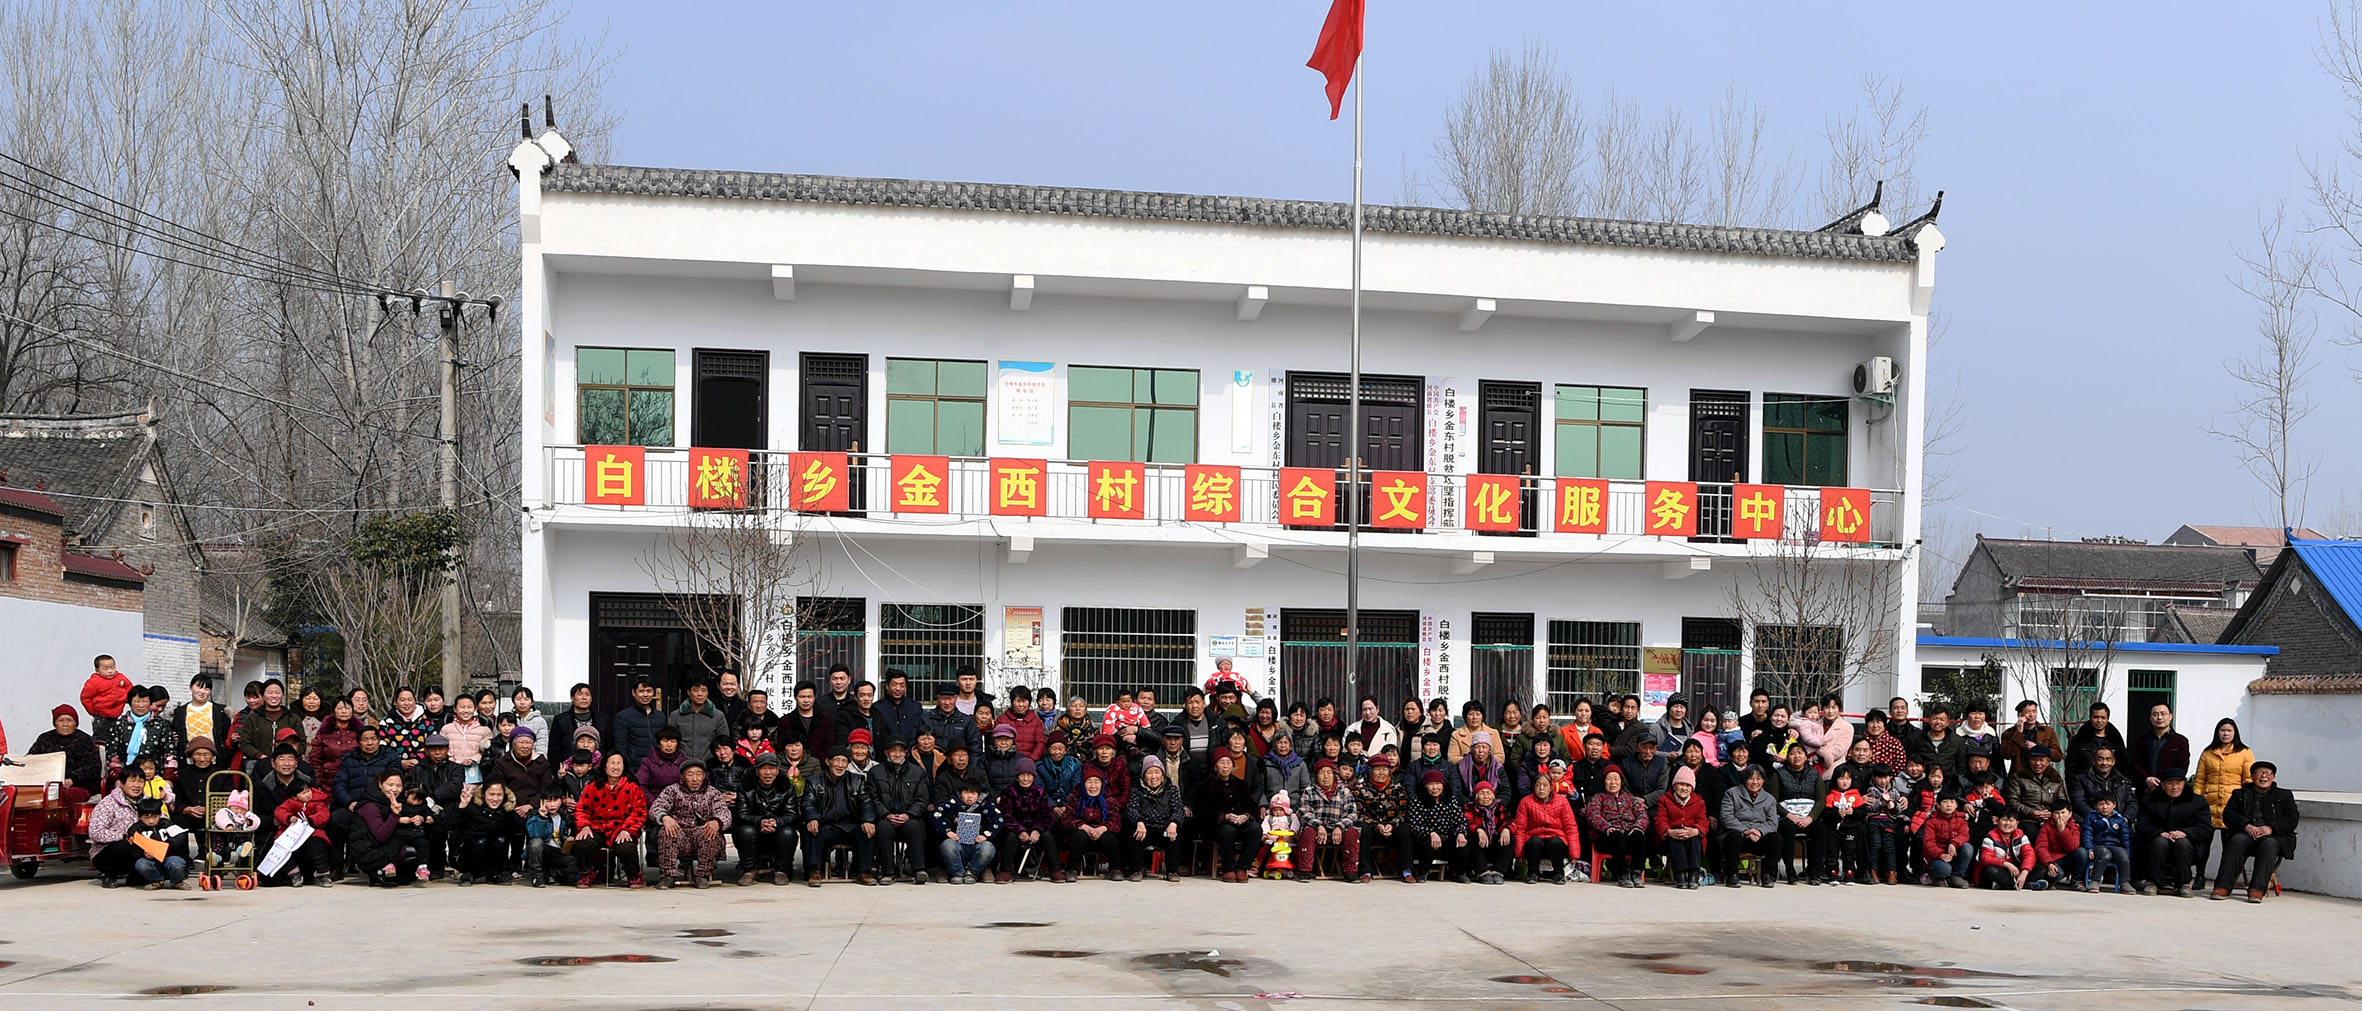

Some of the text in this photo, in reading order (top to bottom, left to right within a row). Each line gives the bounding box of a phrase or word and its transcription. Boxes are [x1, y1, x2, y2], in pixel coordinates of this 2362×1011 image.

[597, 453, 1864, 534] 白楼乡金西村综合文化服务中心
[781, 620, 793, 716] 白楼乡金西村综
[1268, 645, 1276, 701] 白楼乡金西
